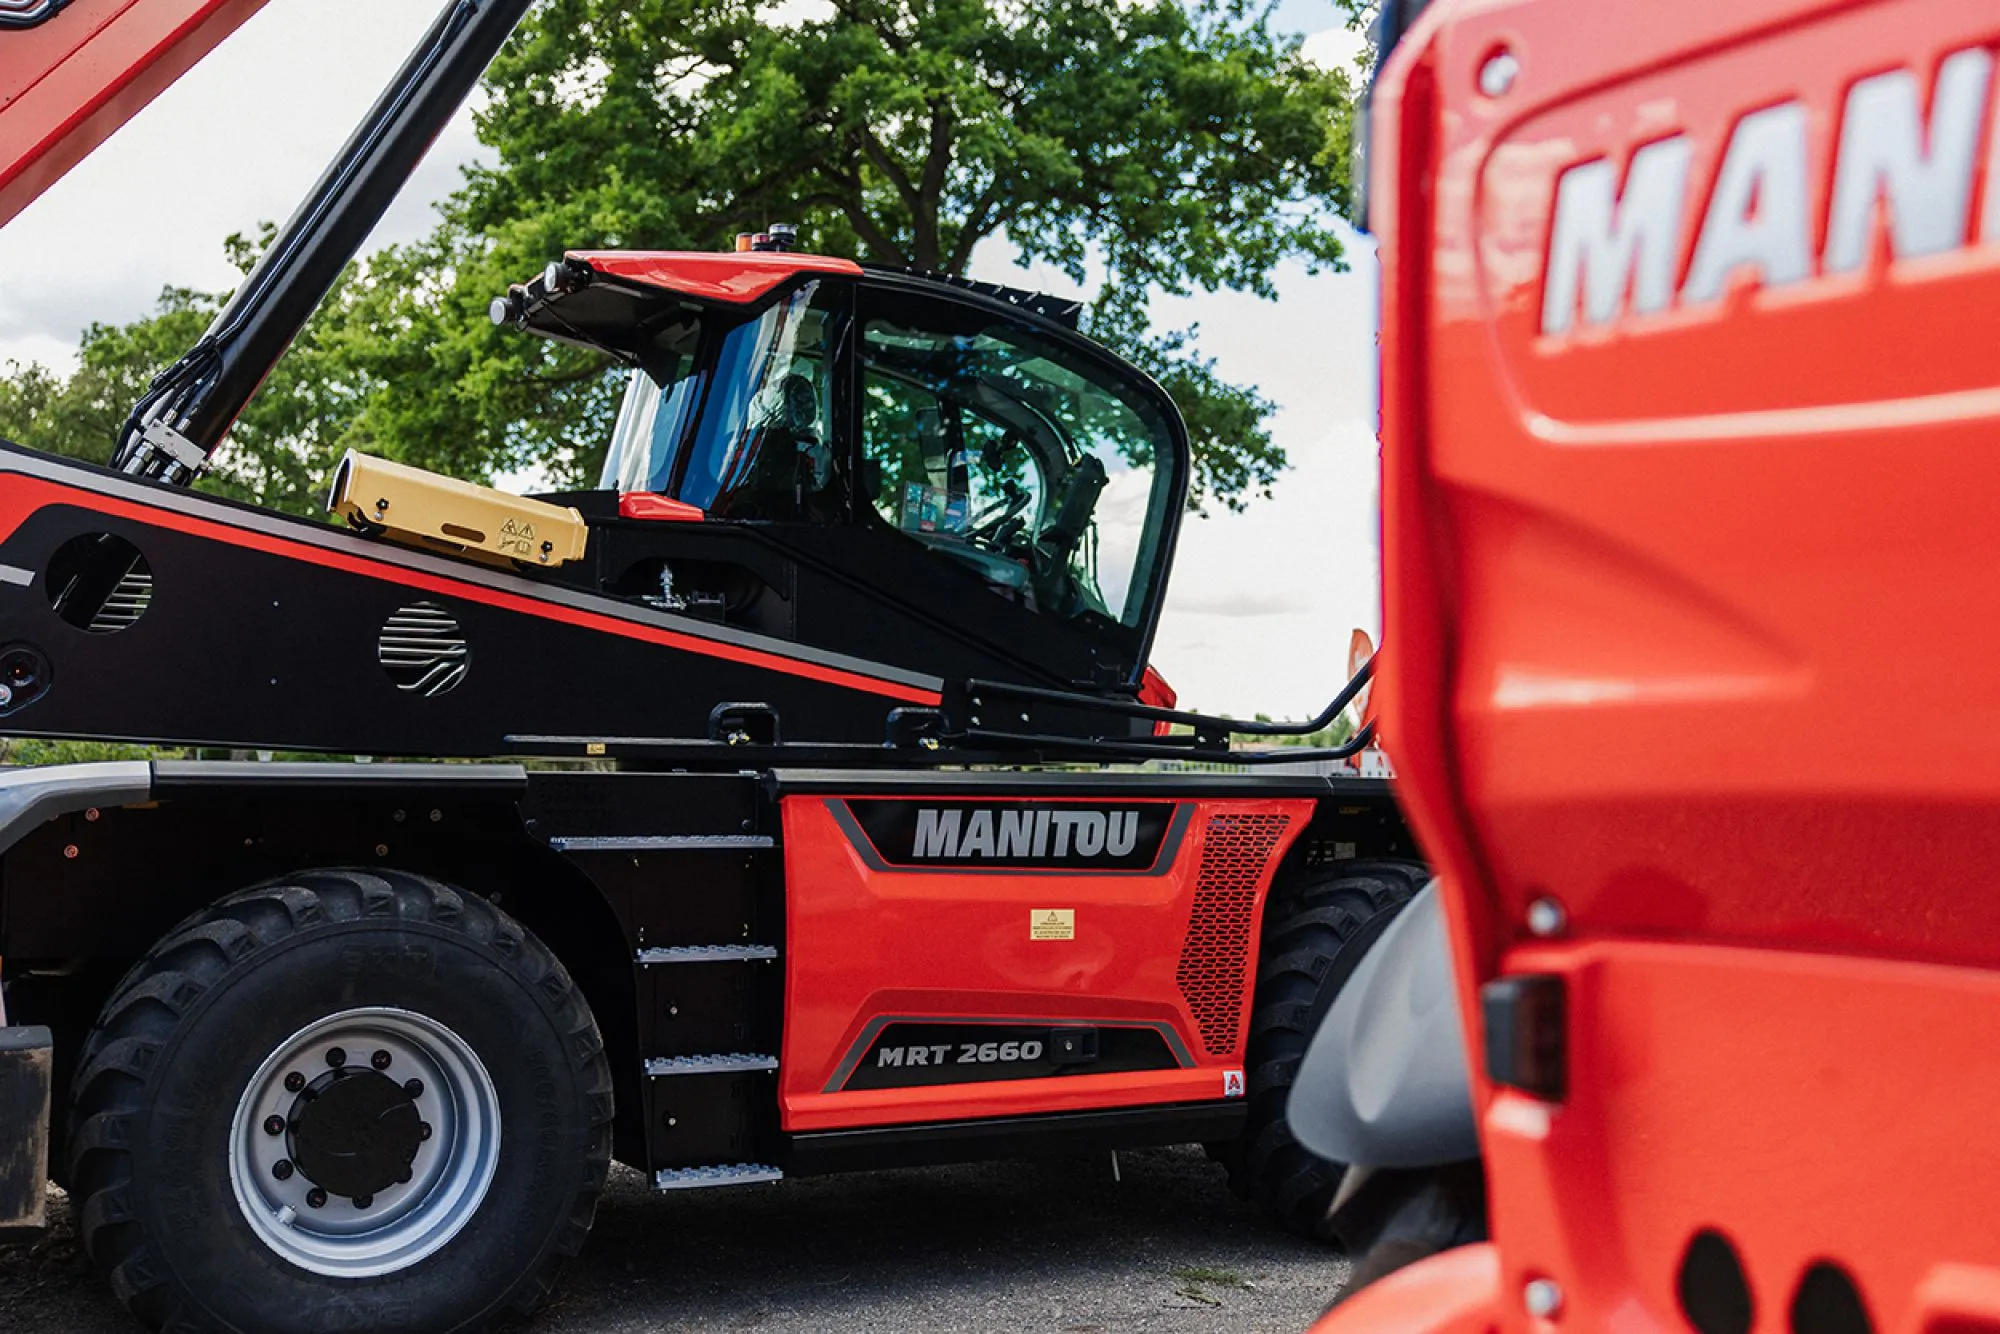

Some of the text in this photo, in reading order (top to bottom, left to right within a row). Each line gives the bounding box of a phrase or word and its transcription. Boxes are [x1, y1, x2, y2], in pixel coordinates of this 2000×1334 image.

[1541, 46, 2000, 336] MAN
[912, 809, 1139, 857] MANITOU
[877, 1041, 1043, 1068] MRT 2660
